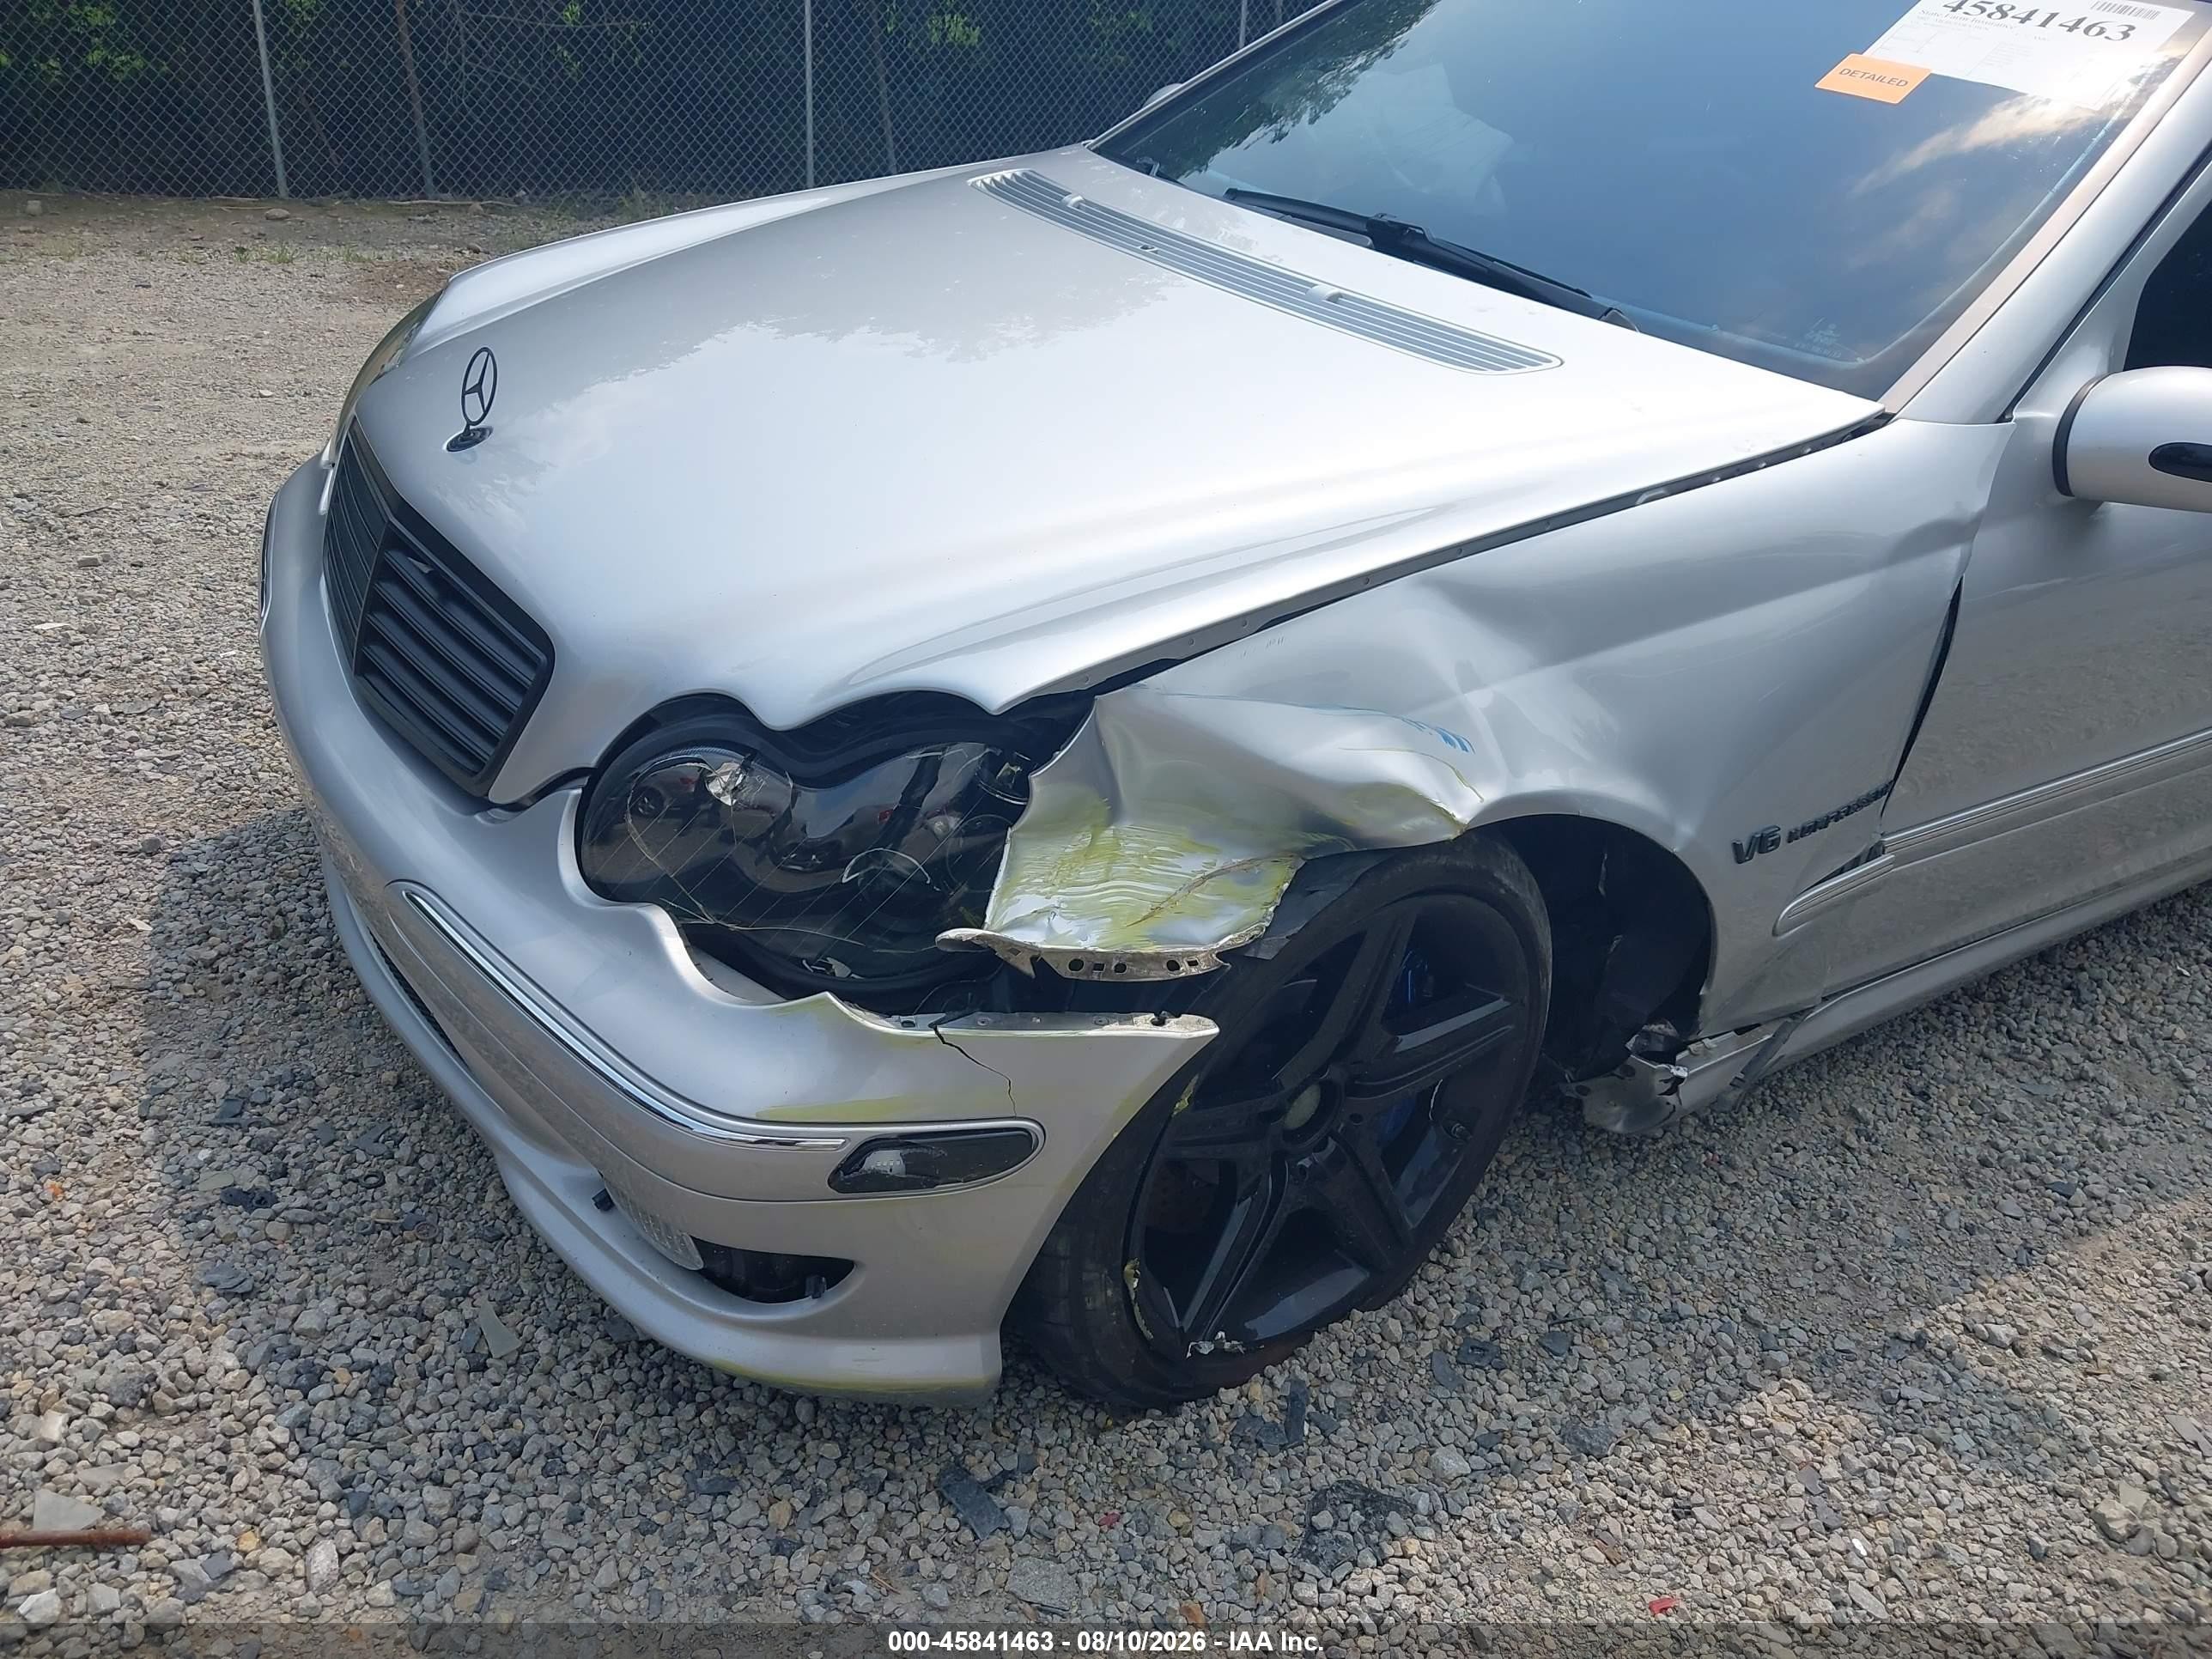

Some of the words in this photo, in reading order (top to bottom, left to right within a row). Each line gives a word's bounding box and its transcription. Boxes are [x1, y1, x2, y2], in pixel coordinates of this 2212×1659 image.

[1942, 0, 2136, 40] 45841463
[1838, 68, 1909, 87] DETAILED
[1731, 824, 1781, 865] V6
